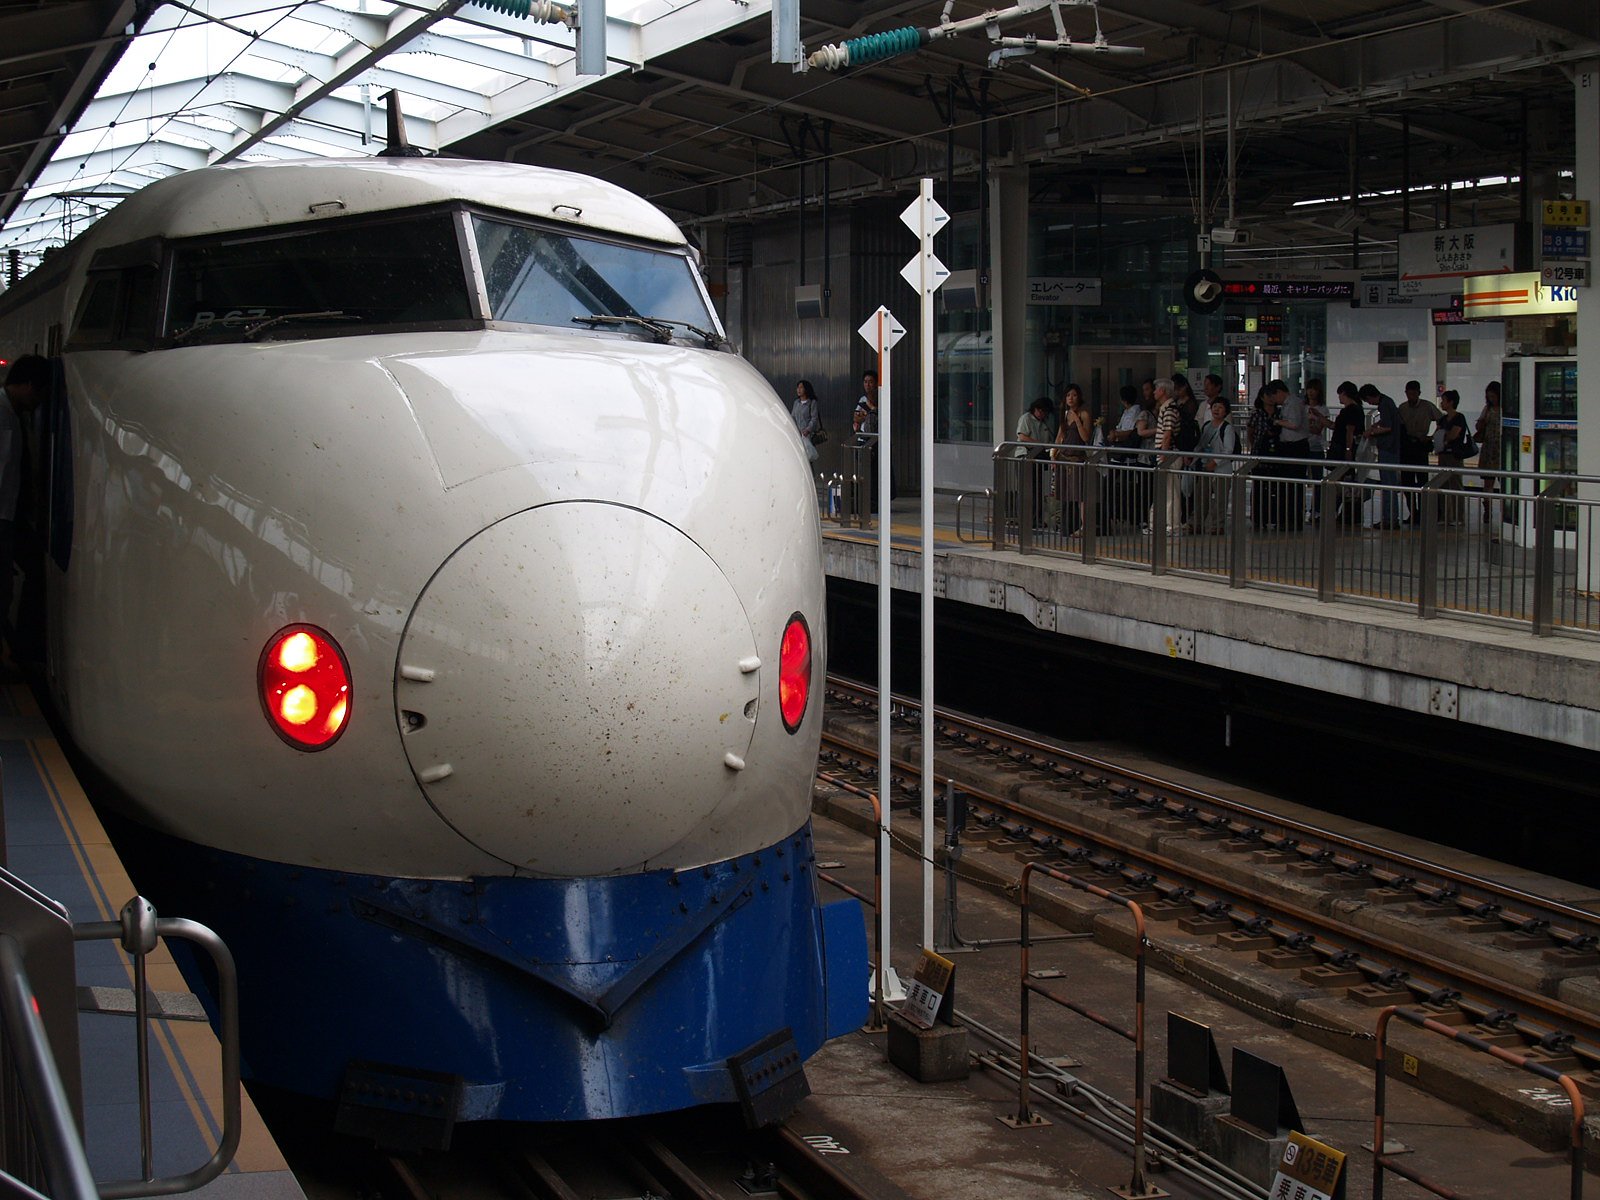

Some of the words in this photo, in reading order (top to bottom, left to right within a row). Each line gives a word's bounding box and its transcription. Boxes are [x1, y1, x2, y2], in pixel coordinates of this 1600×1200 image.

[1434, 233, 1475, 252] 新大阪
[1436, 253, 1472, 262] しんおおさか
[1440, 262, 1469, 272] Shin-Osaka
[1553, 266, 1585, 280] 12号車
[1031, 282, 1096, 293] エレベーター
[1295, 1145, 1339, 1184] 13号車
